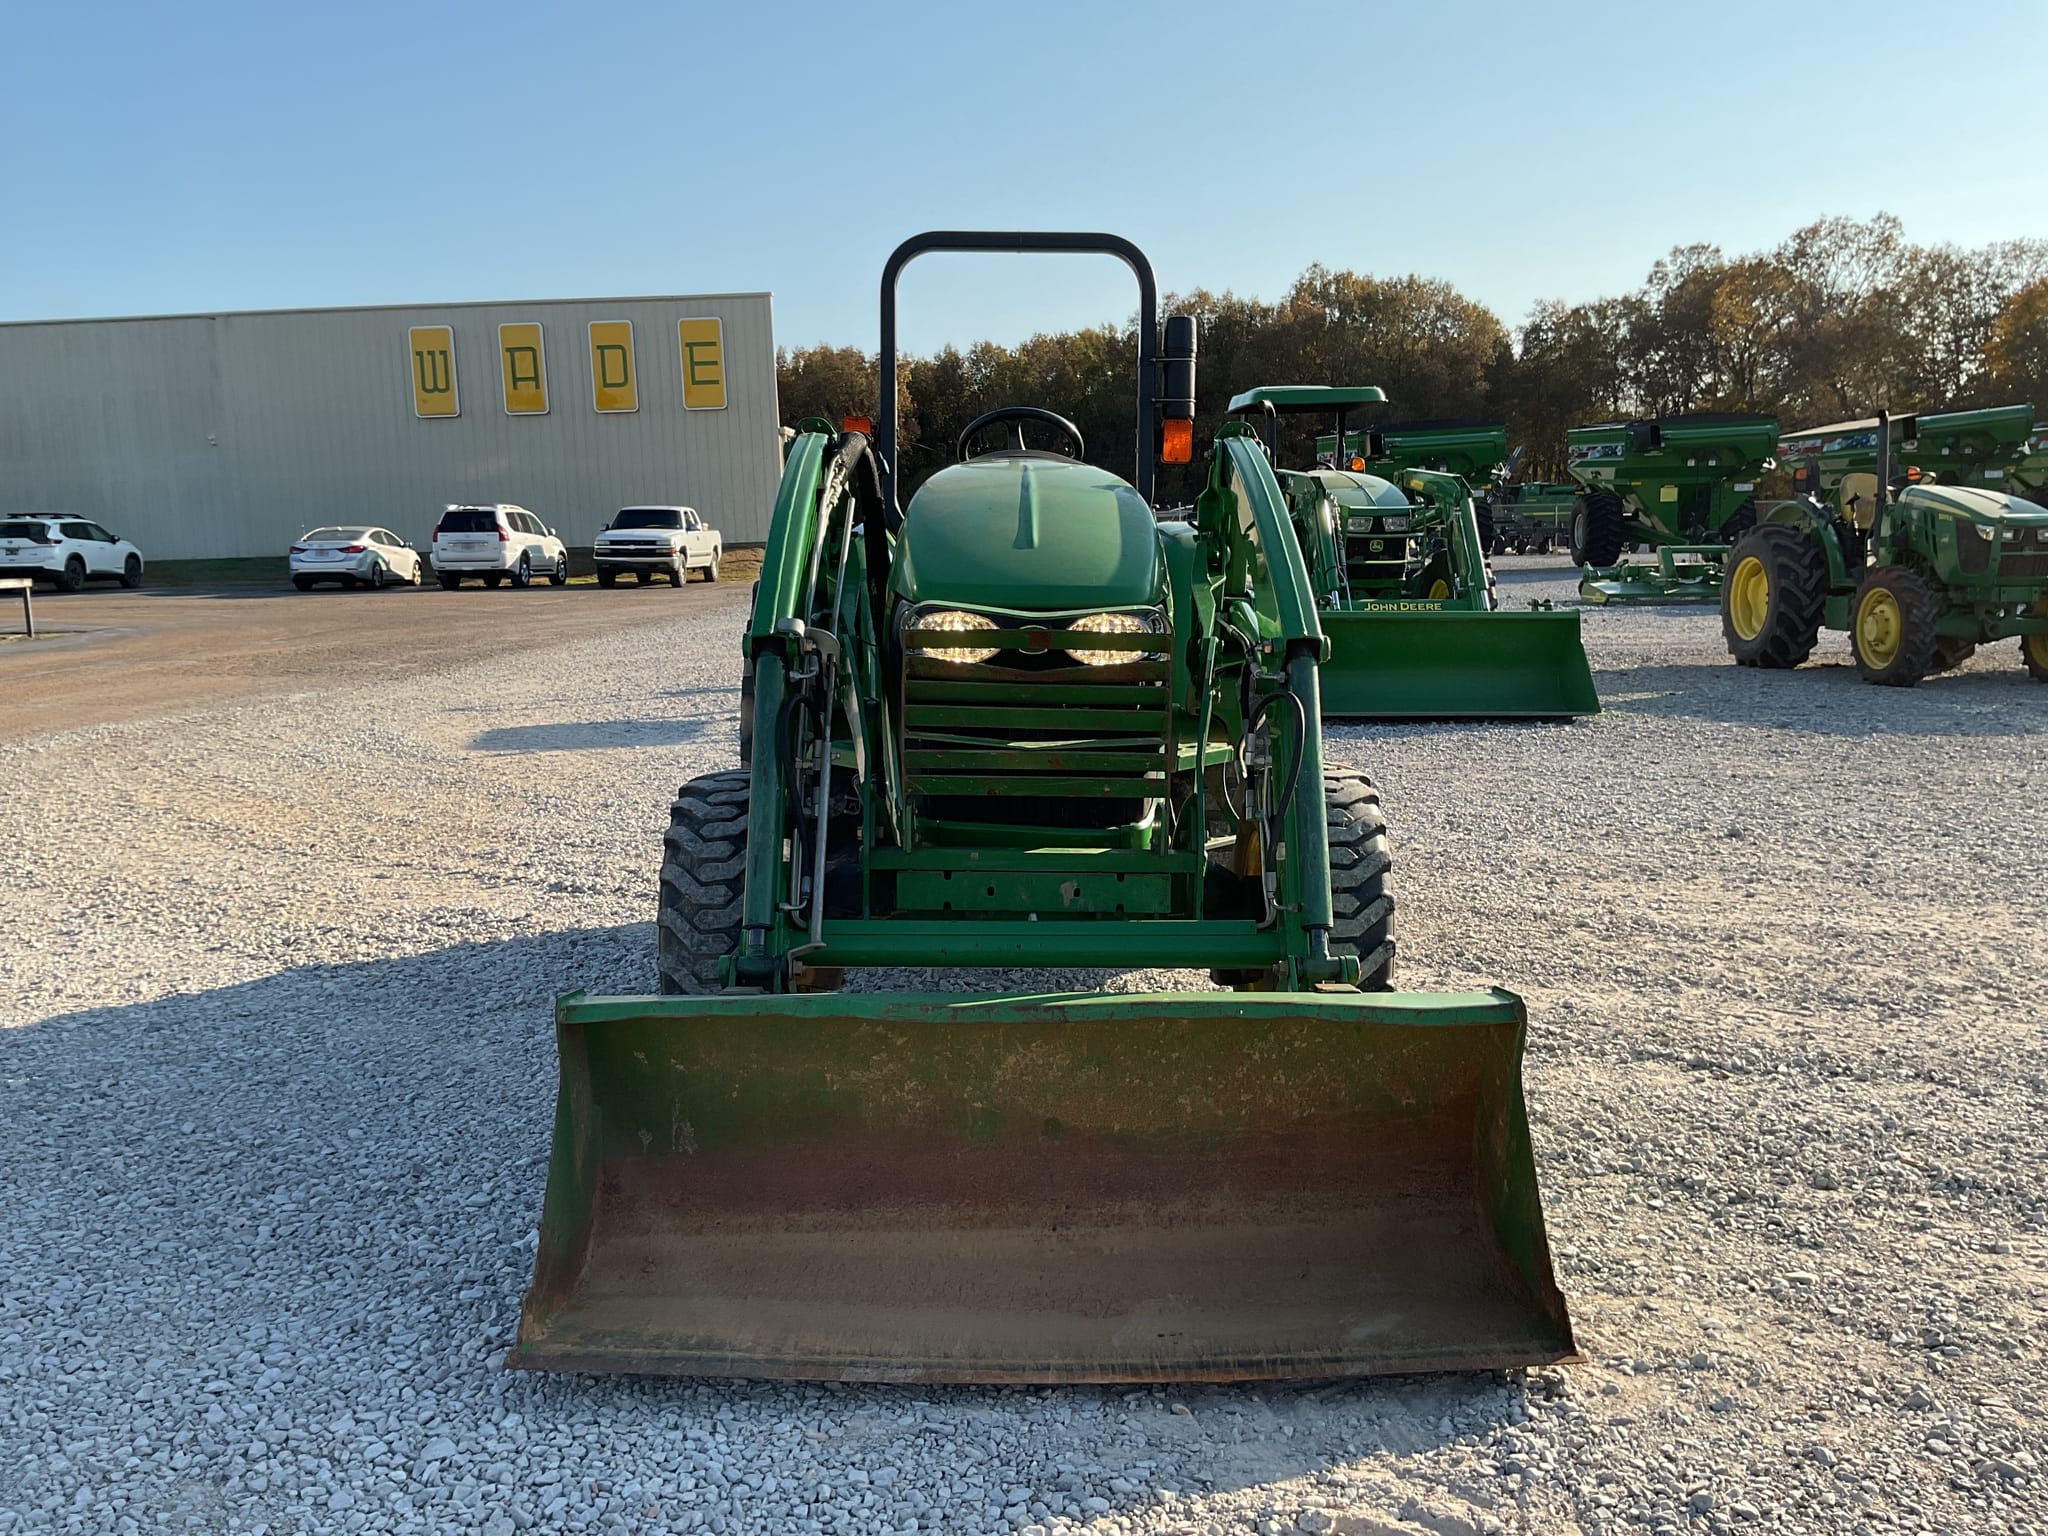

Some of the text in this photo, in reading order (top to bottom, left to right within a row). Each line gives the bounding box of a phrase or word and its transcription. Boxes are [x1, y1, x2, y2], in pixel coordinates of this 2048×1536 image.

[415, 341, 720, 394] WADE
[1364, 602, 1442, 611] JOHN DEERE
